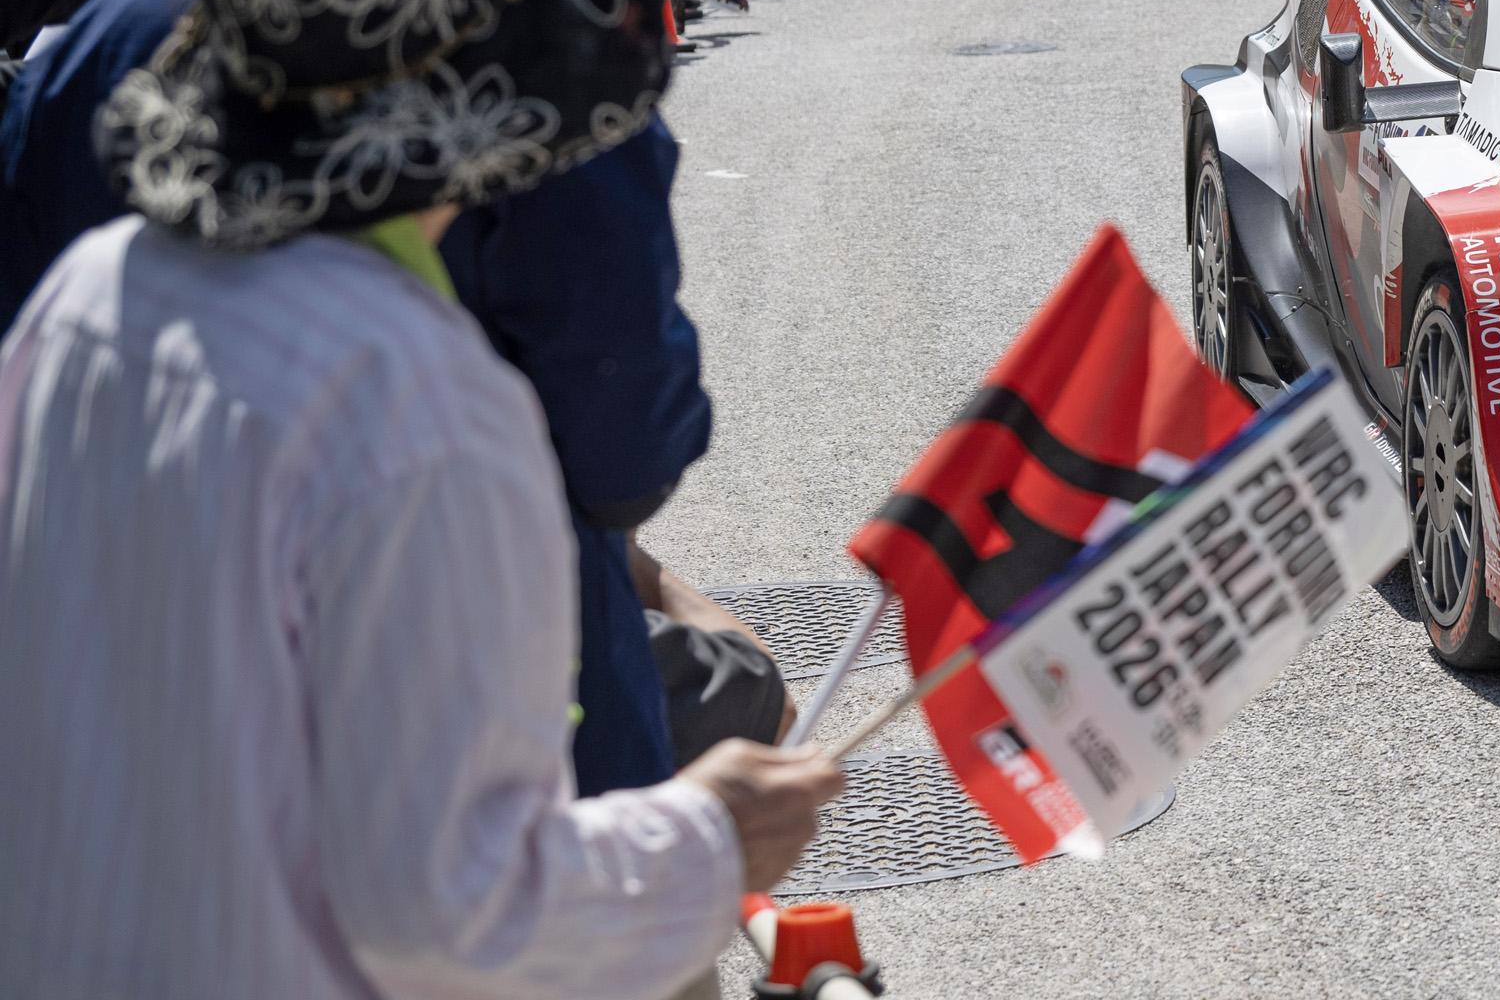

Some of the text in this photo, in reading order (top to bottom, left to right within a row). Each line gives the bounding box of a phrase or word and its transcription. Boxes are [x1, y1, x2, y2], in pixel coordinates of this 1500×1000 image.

[1286, 412, 1371, 522] WRC
[1128, 543, 1245, 687] JAPAN
[1180, 500, 1292, 639] RALLY
[1075, 582, 1180, 710] 2026
